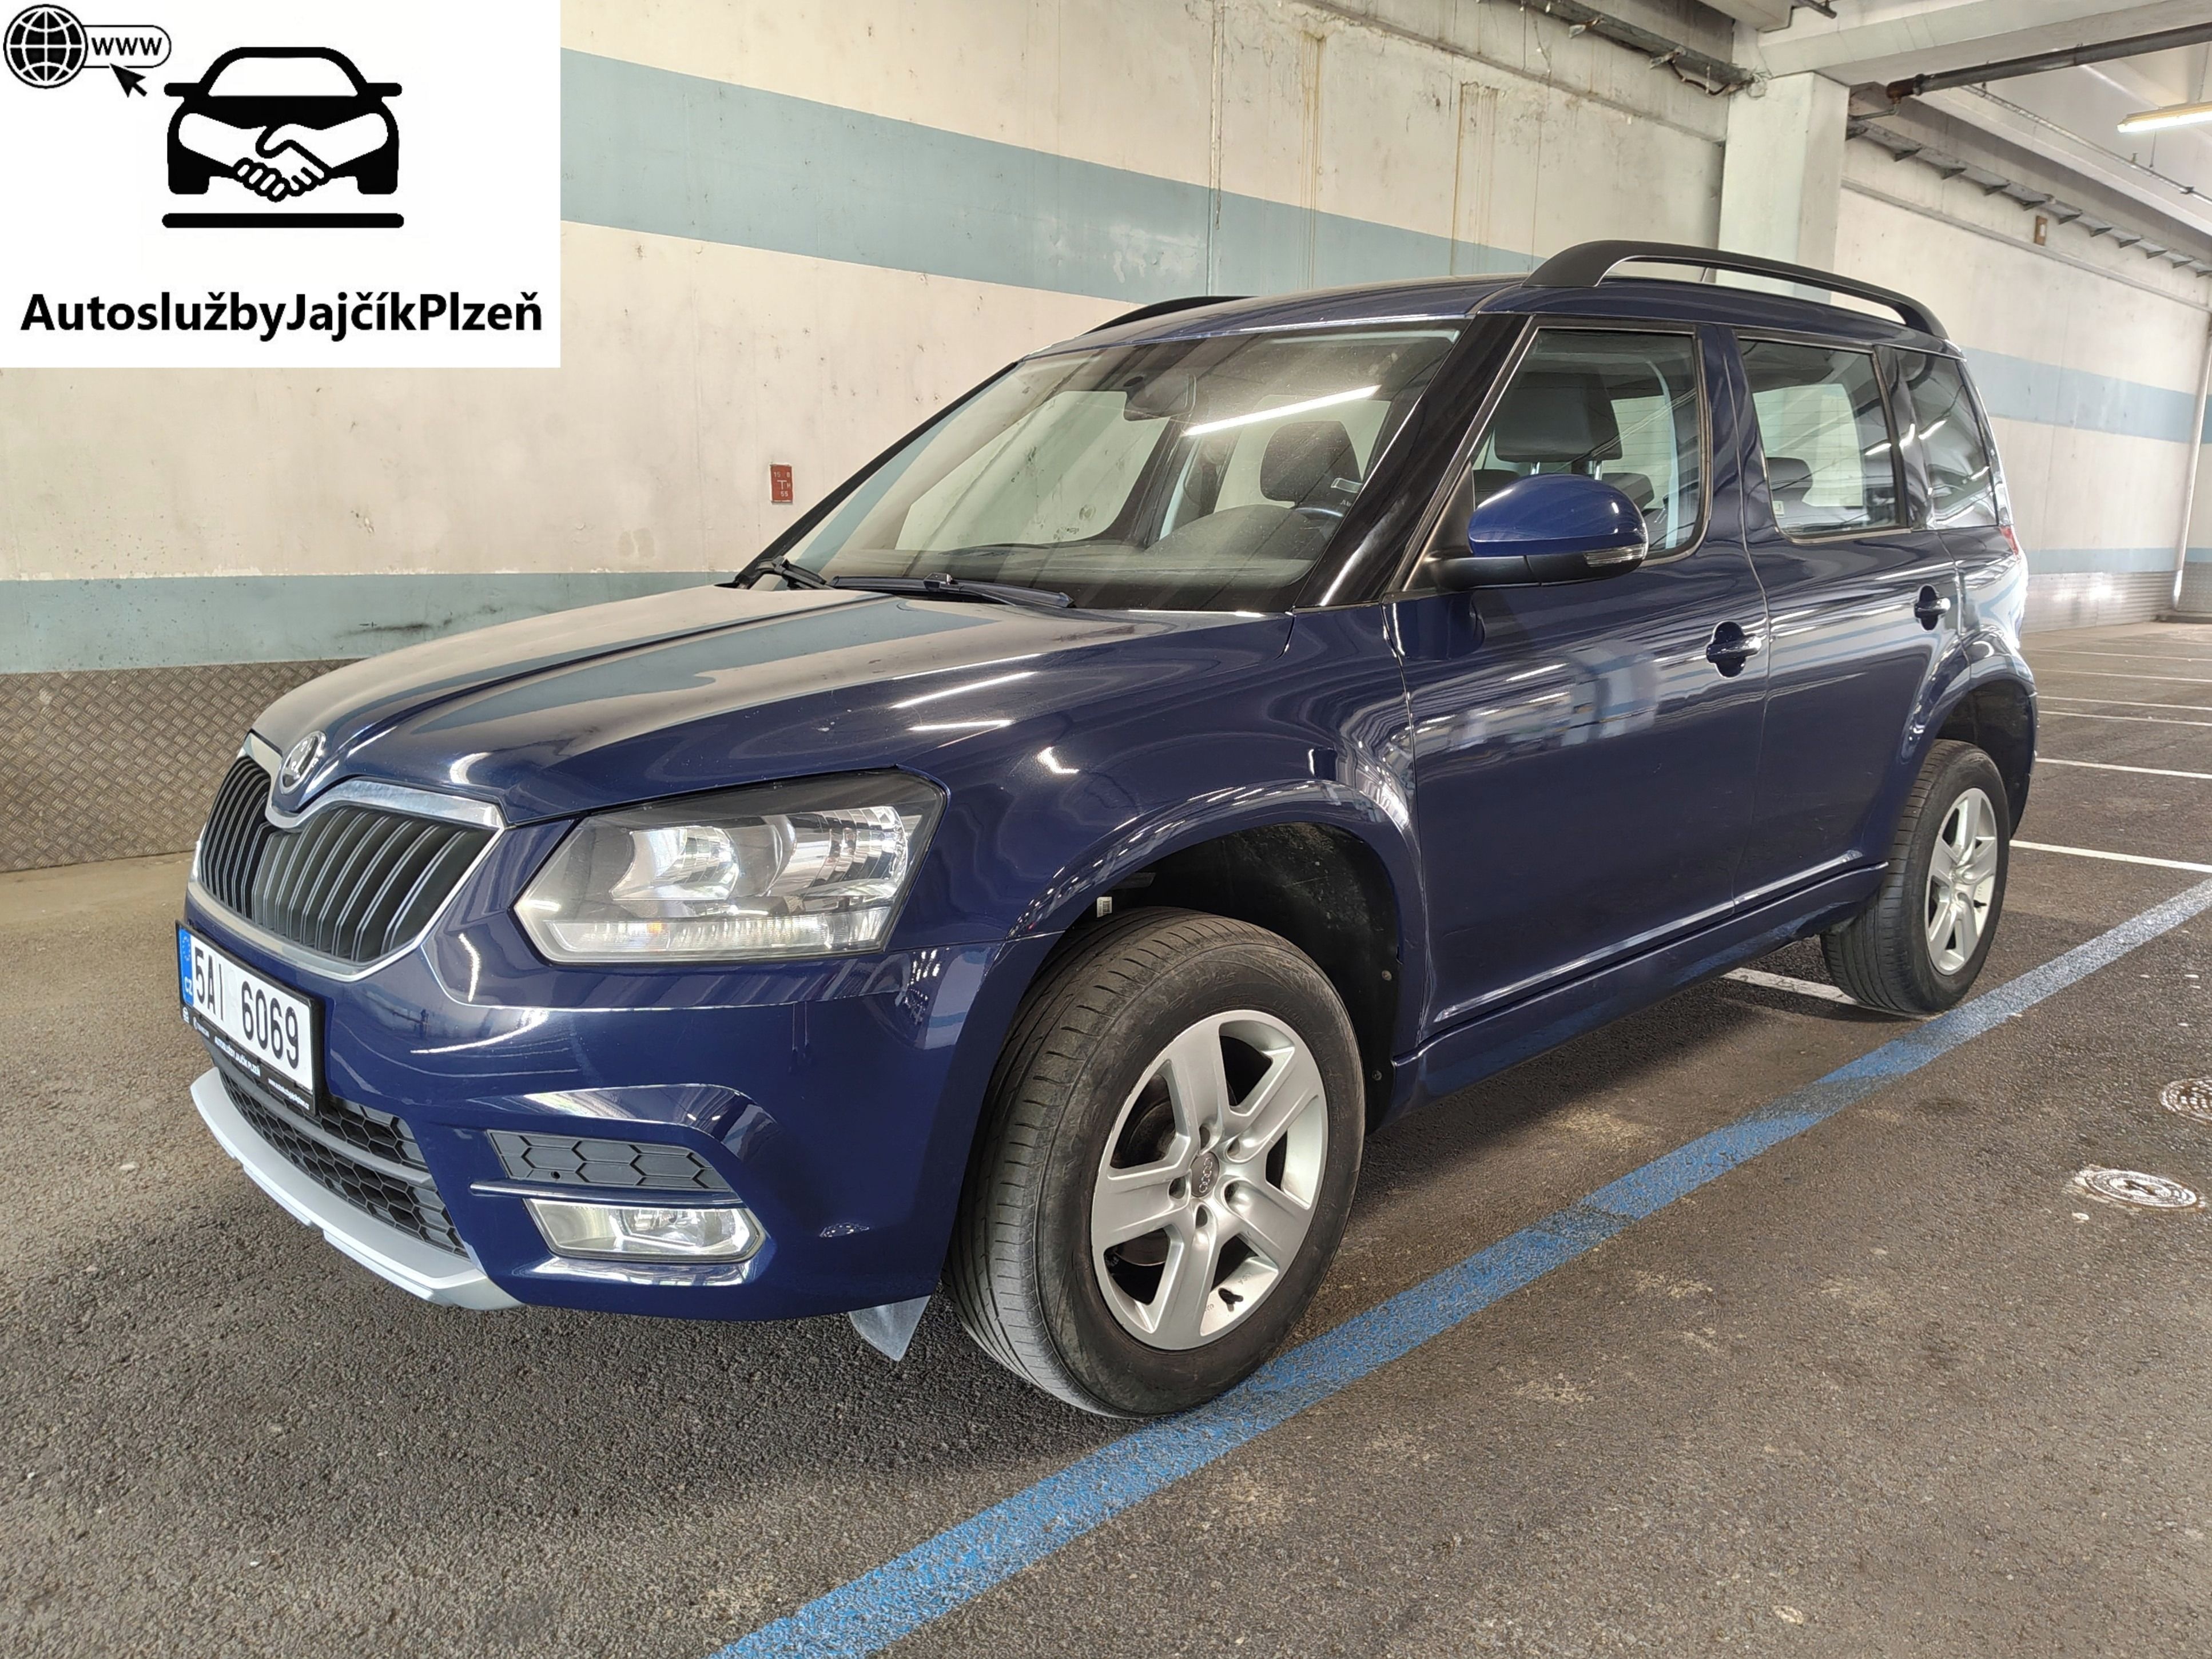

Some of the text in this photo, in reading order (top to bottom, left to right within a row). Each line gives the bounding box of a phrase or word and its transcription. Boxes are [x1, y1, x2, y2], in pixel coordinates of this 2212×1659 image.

[777, 480, 787, 490] T
[184, 976, 193, 996] CZ
[241, 981, 299, 1069] 6069
